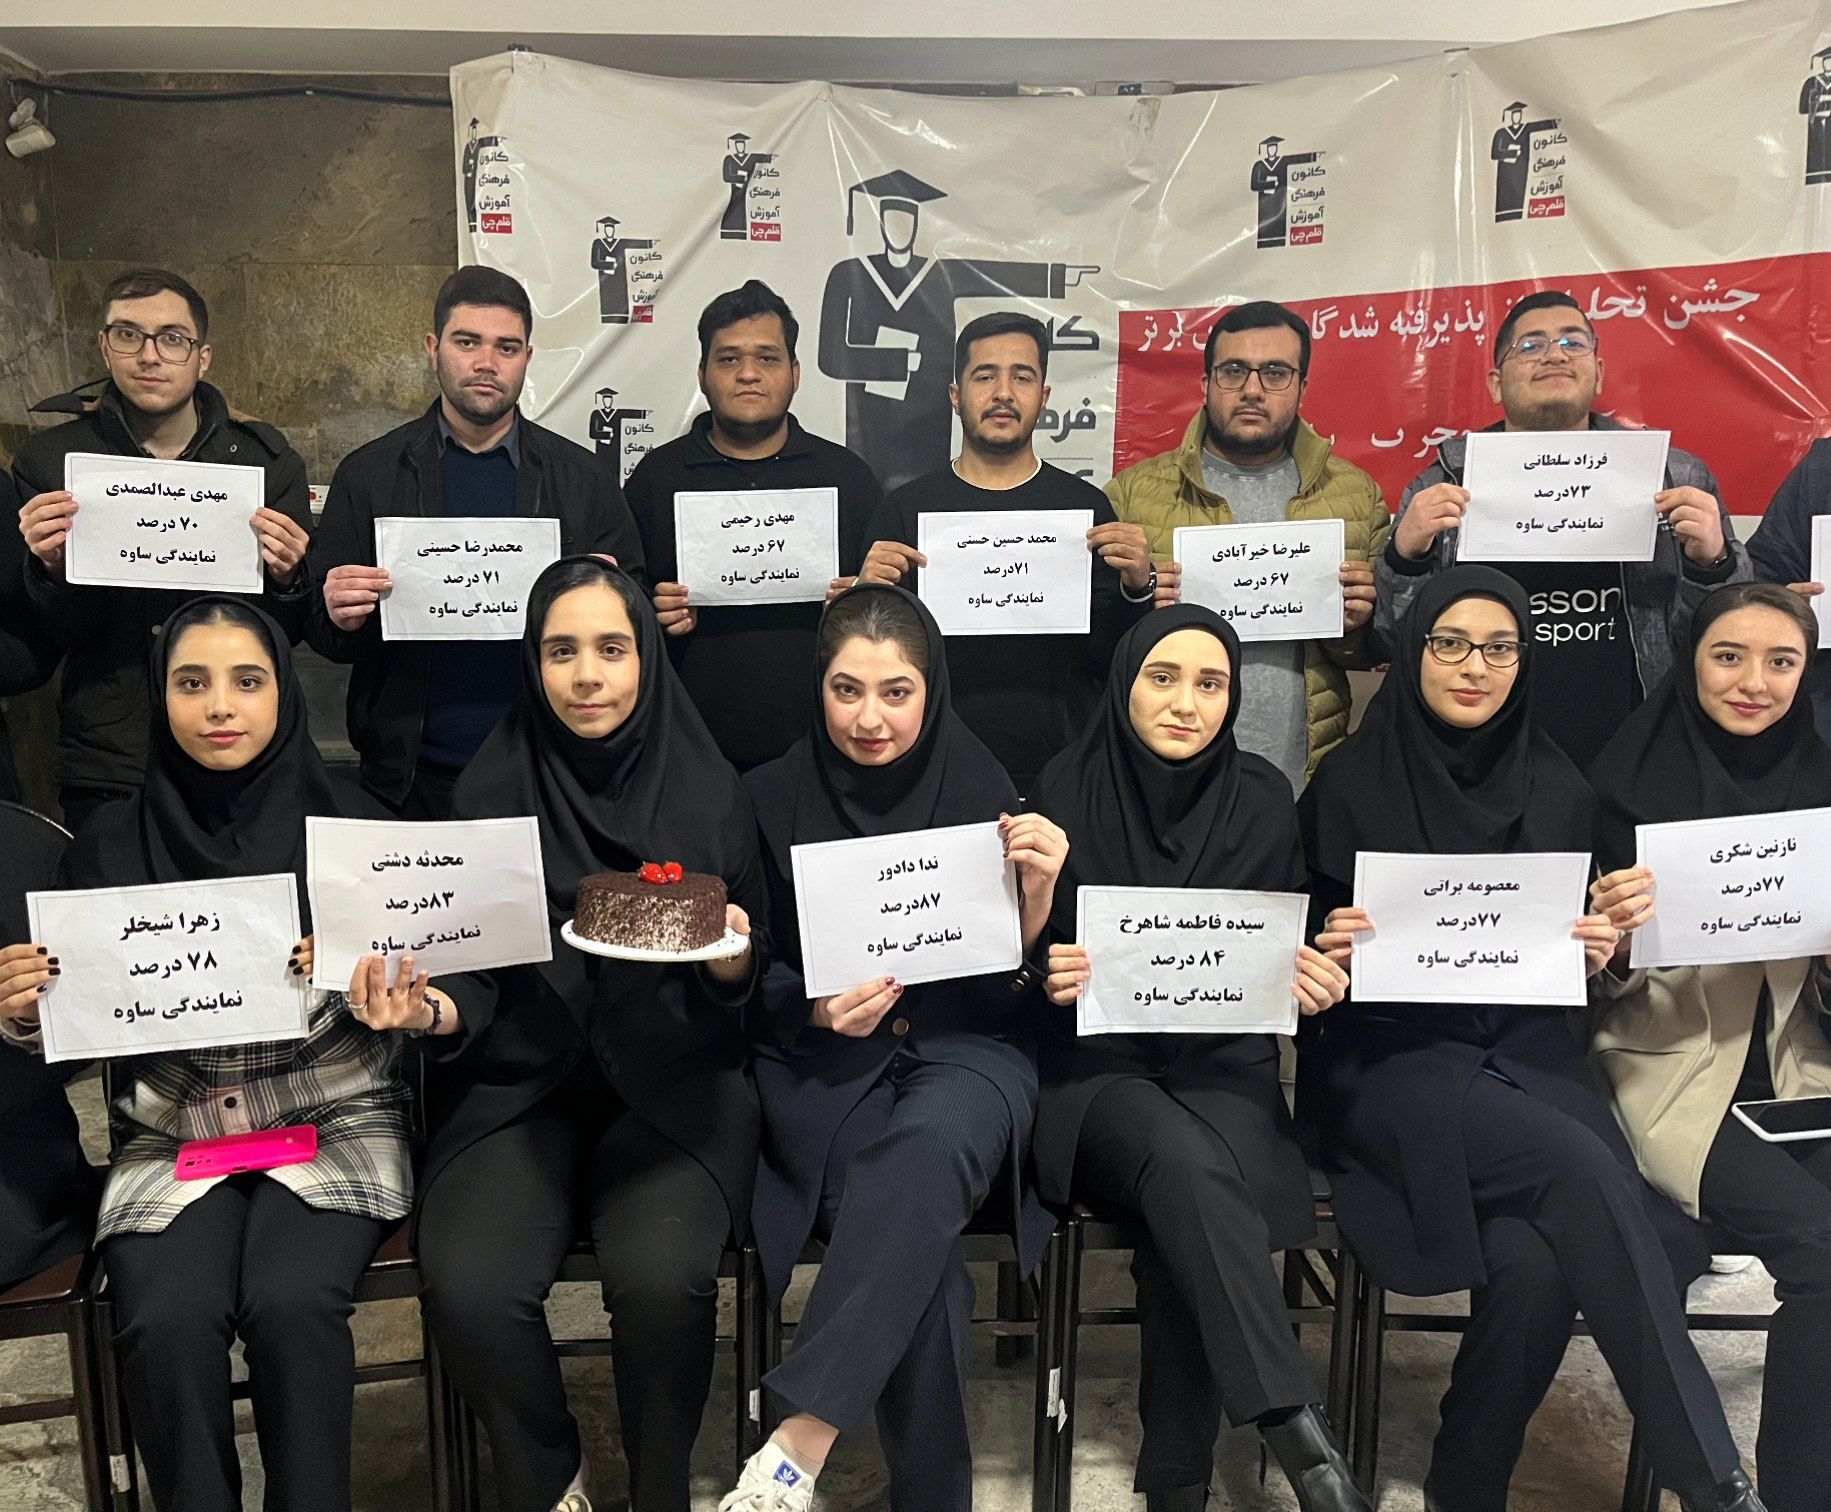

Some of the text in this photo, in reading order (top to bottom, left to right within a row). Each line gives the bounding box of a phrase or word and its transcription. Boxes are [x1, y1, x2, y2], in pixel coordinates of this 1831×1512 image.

[1533, 133, 1568, 150] کانون
[479, 151, 509, 165] کانون
[1291, 166, 1326, 181] کانون
[1530, 175, 1564, 196] آموزش
[479, 194, 511, 210] آموزش
[750, 206, 780, 220] آموزش
[1290, 205, 1325, 224] آموزش
[629, 252, 663, 264] کانون
[1664, 278, 1760, 330] جشن
[624, 424, 655, 435] کانون
[1523, 452, 1608, 470] فرزاد سلطانی
[106, 483, 228, 503] مهدی عبدالصمدی
[136, 516, 198, 532] ۷۰ درصد
[721, 513, 795, 528] مهدی رحیمی
[1516, 517, 1604, 533] نمایندگی ساوه
[417, 541, 523, 557] محمدرضا حسینی
[732, 538, 785, 556] ۶۷ درصد
[957, 533, 1057, 548] محمد حسین حسنی
[120, 546, 216, 566] نمایندگی ساوه
[1272, 542, 1311, 558] علیرضا
[443, 570, 500, 588] ۷۱ درصد
[720, 568, 800, 586] نمایندگی ساوه
[1233, 572, 1289, 590] ۶۷ درصد
[968, 592, 1044, 608] نمایندگی ساوه
[429, 601, 518, 618] نمایندگی ساوه
[1220, 602, 1303, 621] نمایندگی ساوه
[1535, 617, 1616, 646] sport
[1710, 837, 1797, 863] نازنین شکری
[371, 850, 464, 872] محدثه دشتی
[877, 856, 939, 881] ندا دادور
[1467, 881, 1520, 896] معصومه
[119, 912, 220, 941] زهرا شیخلر
[1119, 914, 1264, 934] سیده فاطمه شاهرخ
[1701, 910, 1802, 934] نمایندگی ساوه
[372, 925, 481, 955] نمایندگی ساوه
[867, 926, 963, 956] نمایندگی ساوه
[129, 950, 217, 978] ۷۸ درصد
[1150, 949, 1226, 970] ۸۴ درصد
[1417, 950, 1519, 968] نمایندگی ساوه
[1134, 987, 1243, 1006] نمایندگی ساوه
[114, 990, 243, 1023] نمایندگی ساوه
